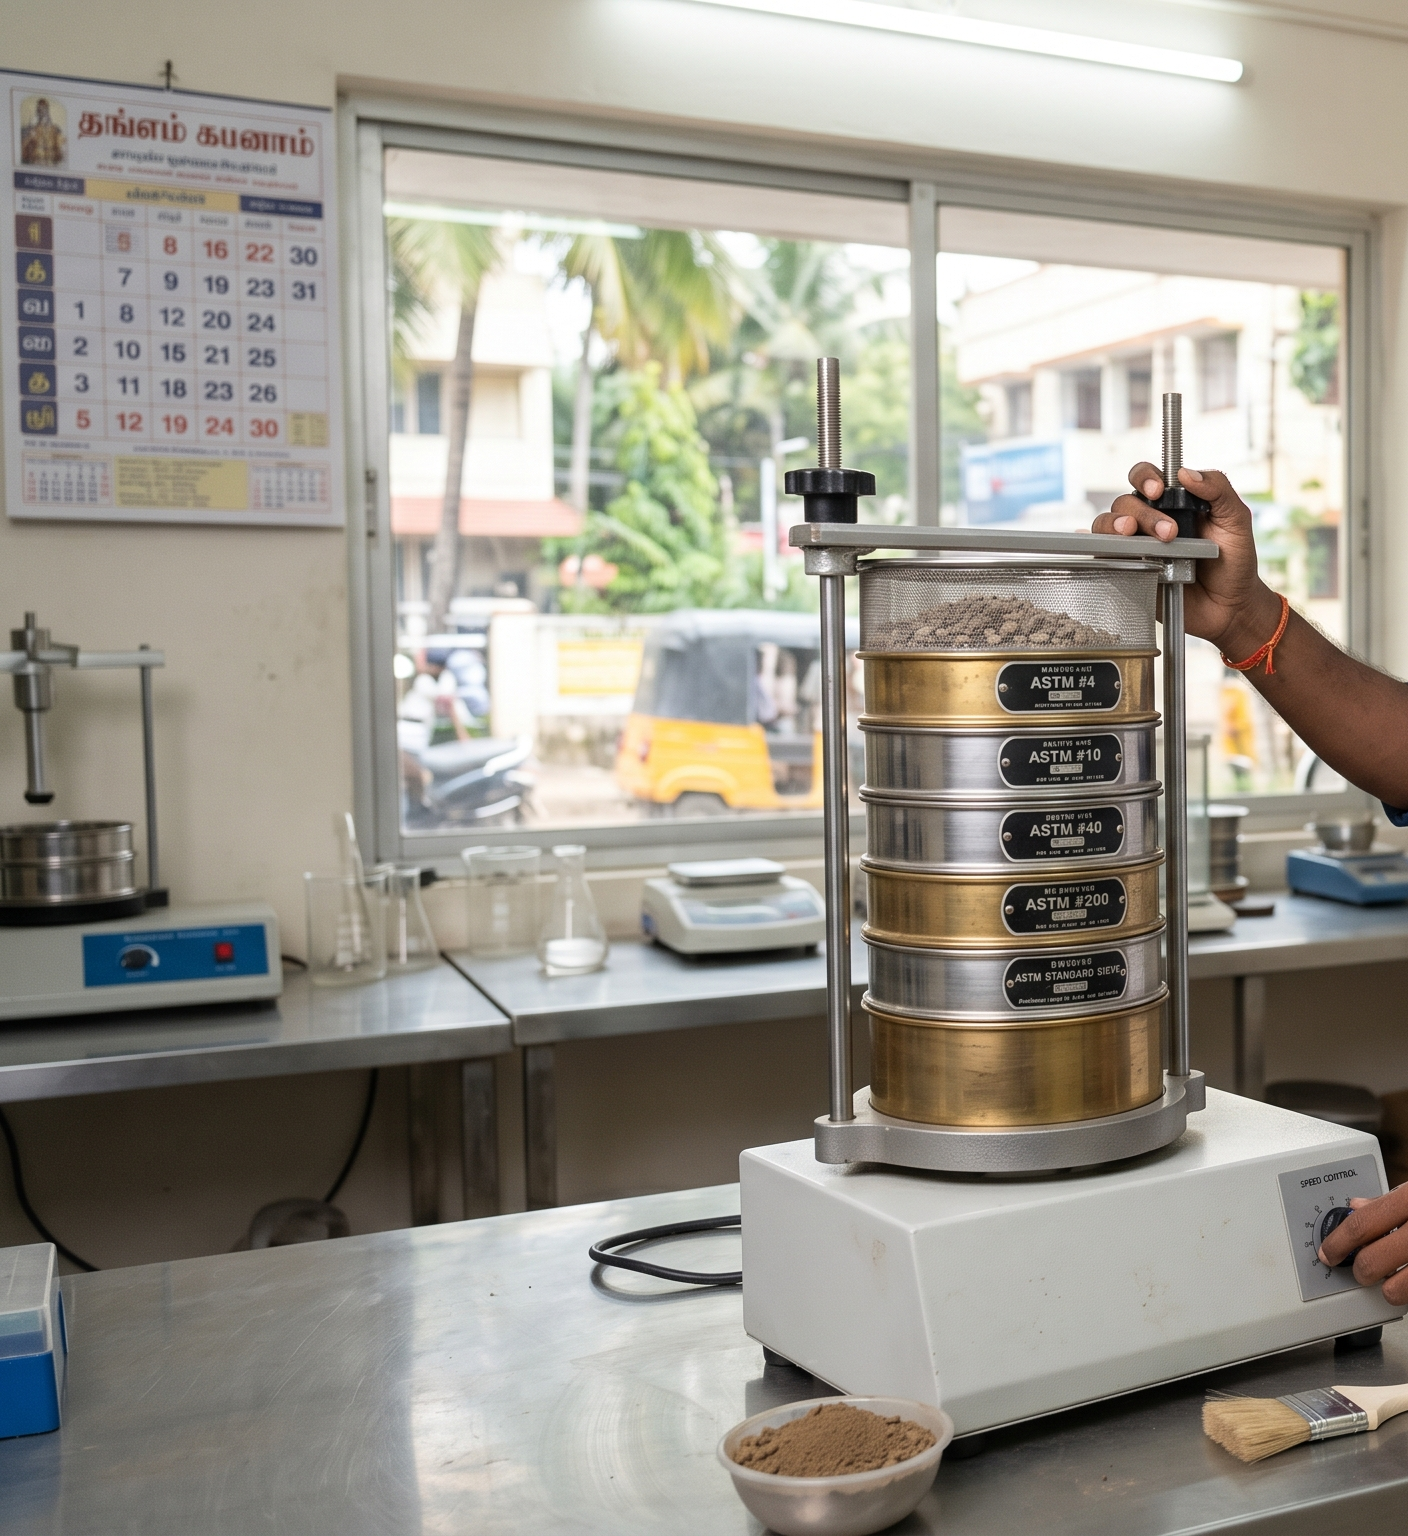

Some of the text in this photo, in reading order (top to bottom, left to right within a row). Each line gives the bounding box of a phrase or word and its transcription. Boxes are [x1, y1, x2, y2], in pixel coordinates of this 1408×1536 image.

[163, 235, 178, 256] 8
[203, 240, 229, 260] 16
[245, 242, 274, 263] 22
[290, 246, 318, 267] 30
[118, 267, 316, 300] 7 9 19 23 31
[74, 300, 276, 332] 1 8 12 20 24
[73, 336, 277, 368] 2 10 15 21 25
[74, 373, 278, 403] 3 11 18 23 26
[76, 409, 279, 439] 5 12 19 24 30
[1030, 675, 1096, 689] ASTM #4
[1028, 748, 1101, 763] ASTM #10
[1029, 821, 1102, 837] ASTM #40
[1025, 893, 1109, 911] ASTM #200
[1014, 973, 1042, 983] ASTM
[1097, 965, 1120, 976] SIEVE
[1300, 1176, 1322, 1188] SPEED
